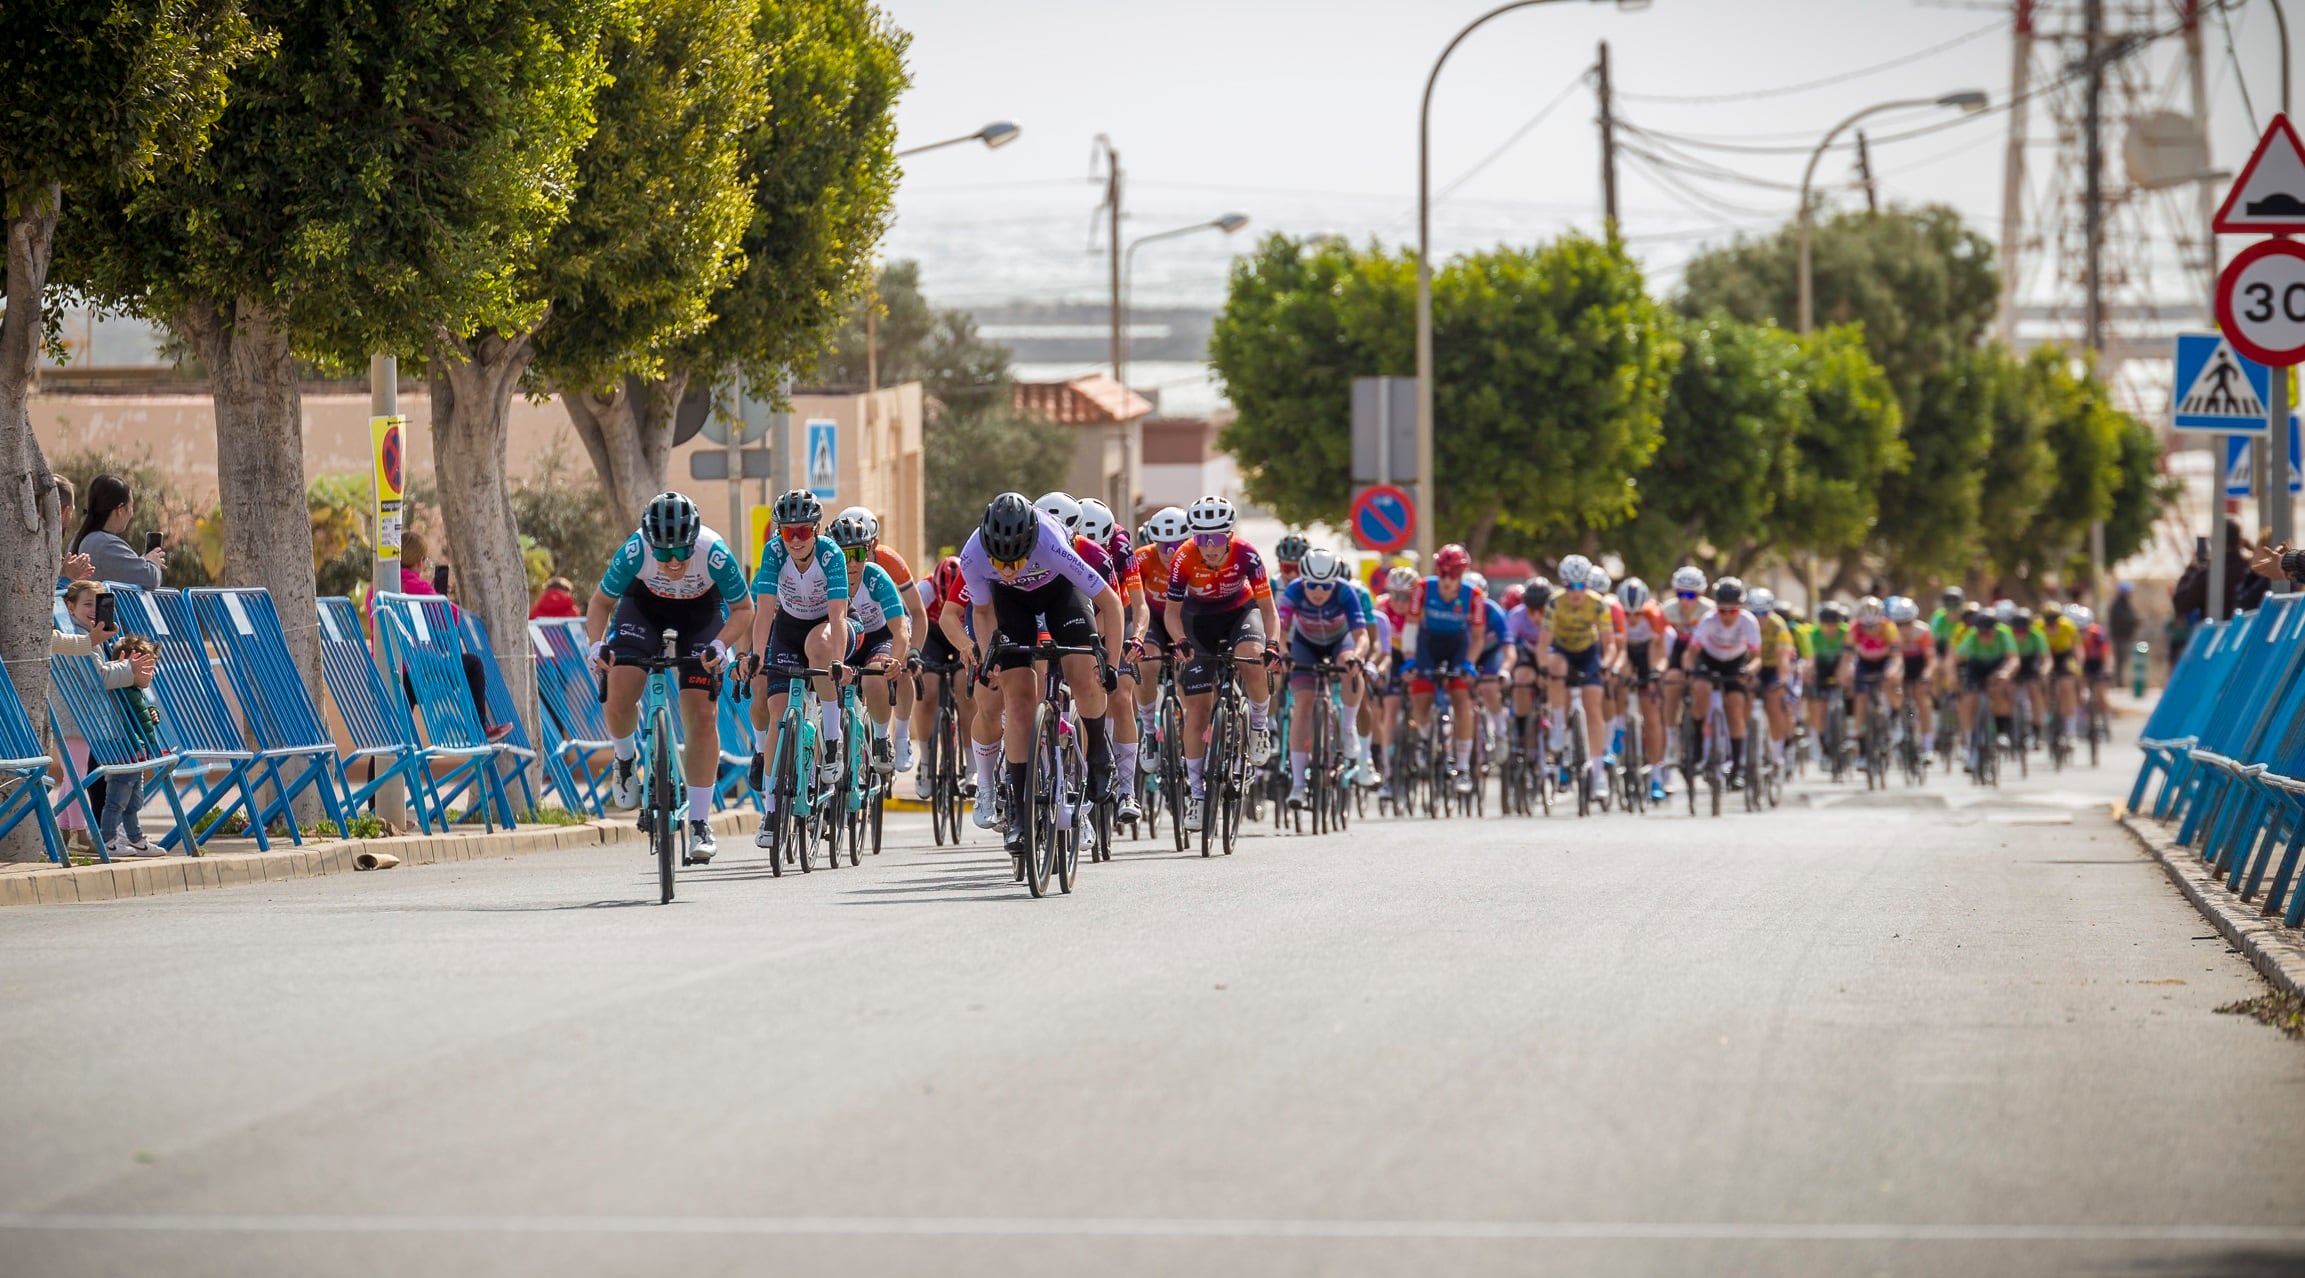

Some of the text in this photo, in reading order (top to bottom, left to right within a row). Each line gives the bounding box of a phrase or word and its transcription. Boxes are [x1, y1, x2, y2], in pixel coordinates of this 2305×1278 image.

[2244, 281, 2305, 323] 30
[1051, 544, 1085, 571] LABORAL
[1172, 551, 1188, 582] THORNE
[999, 570, 1051, 587] ABORA
